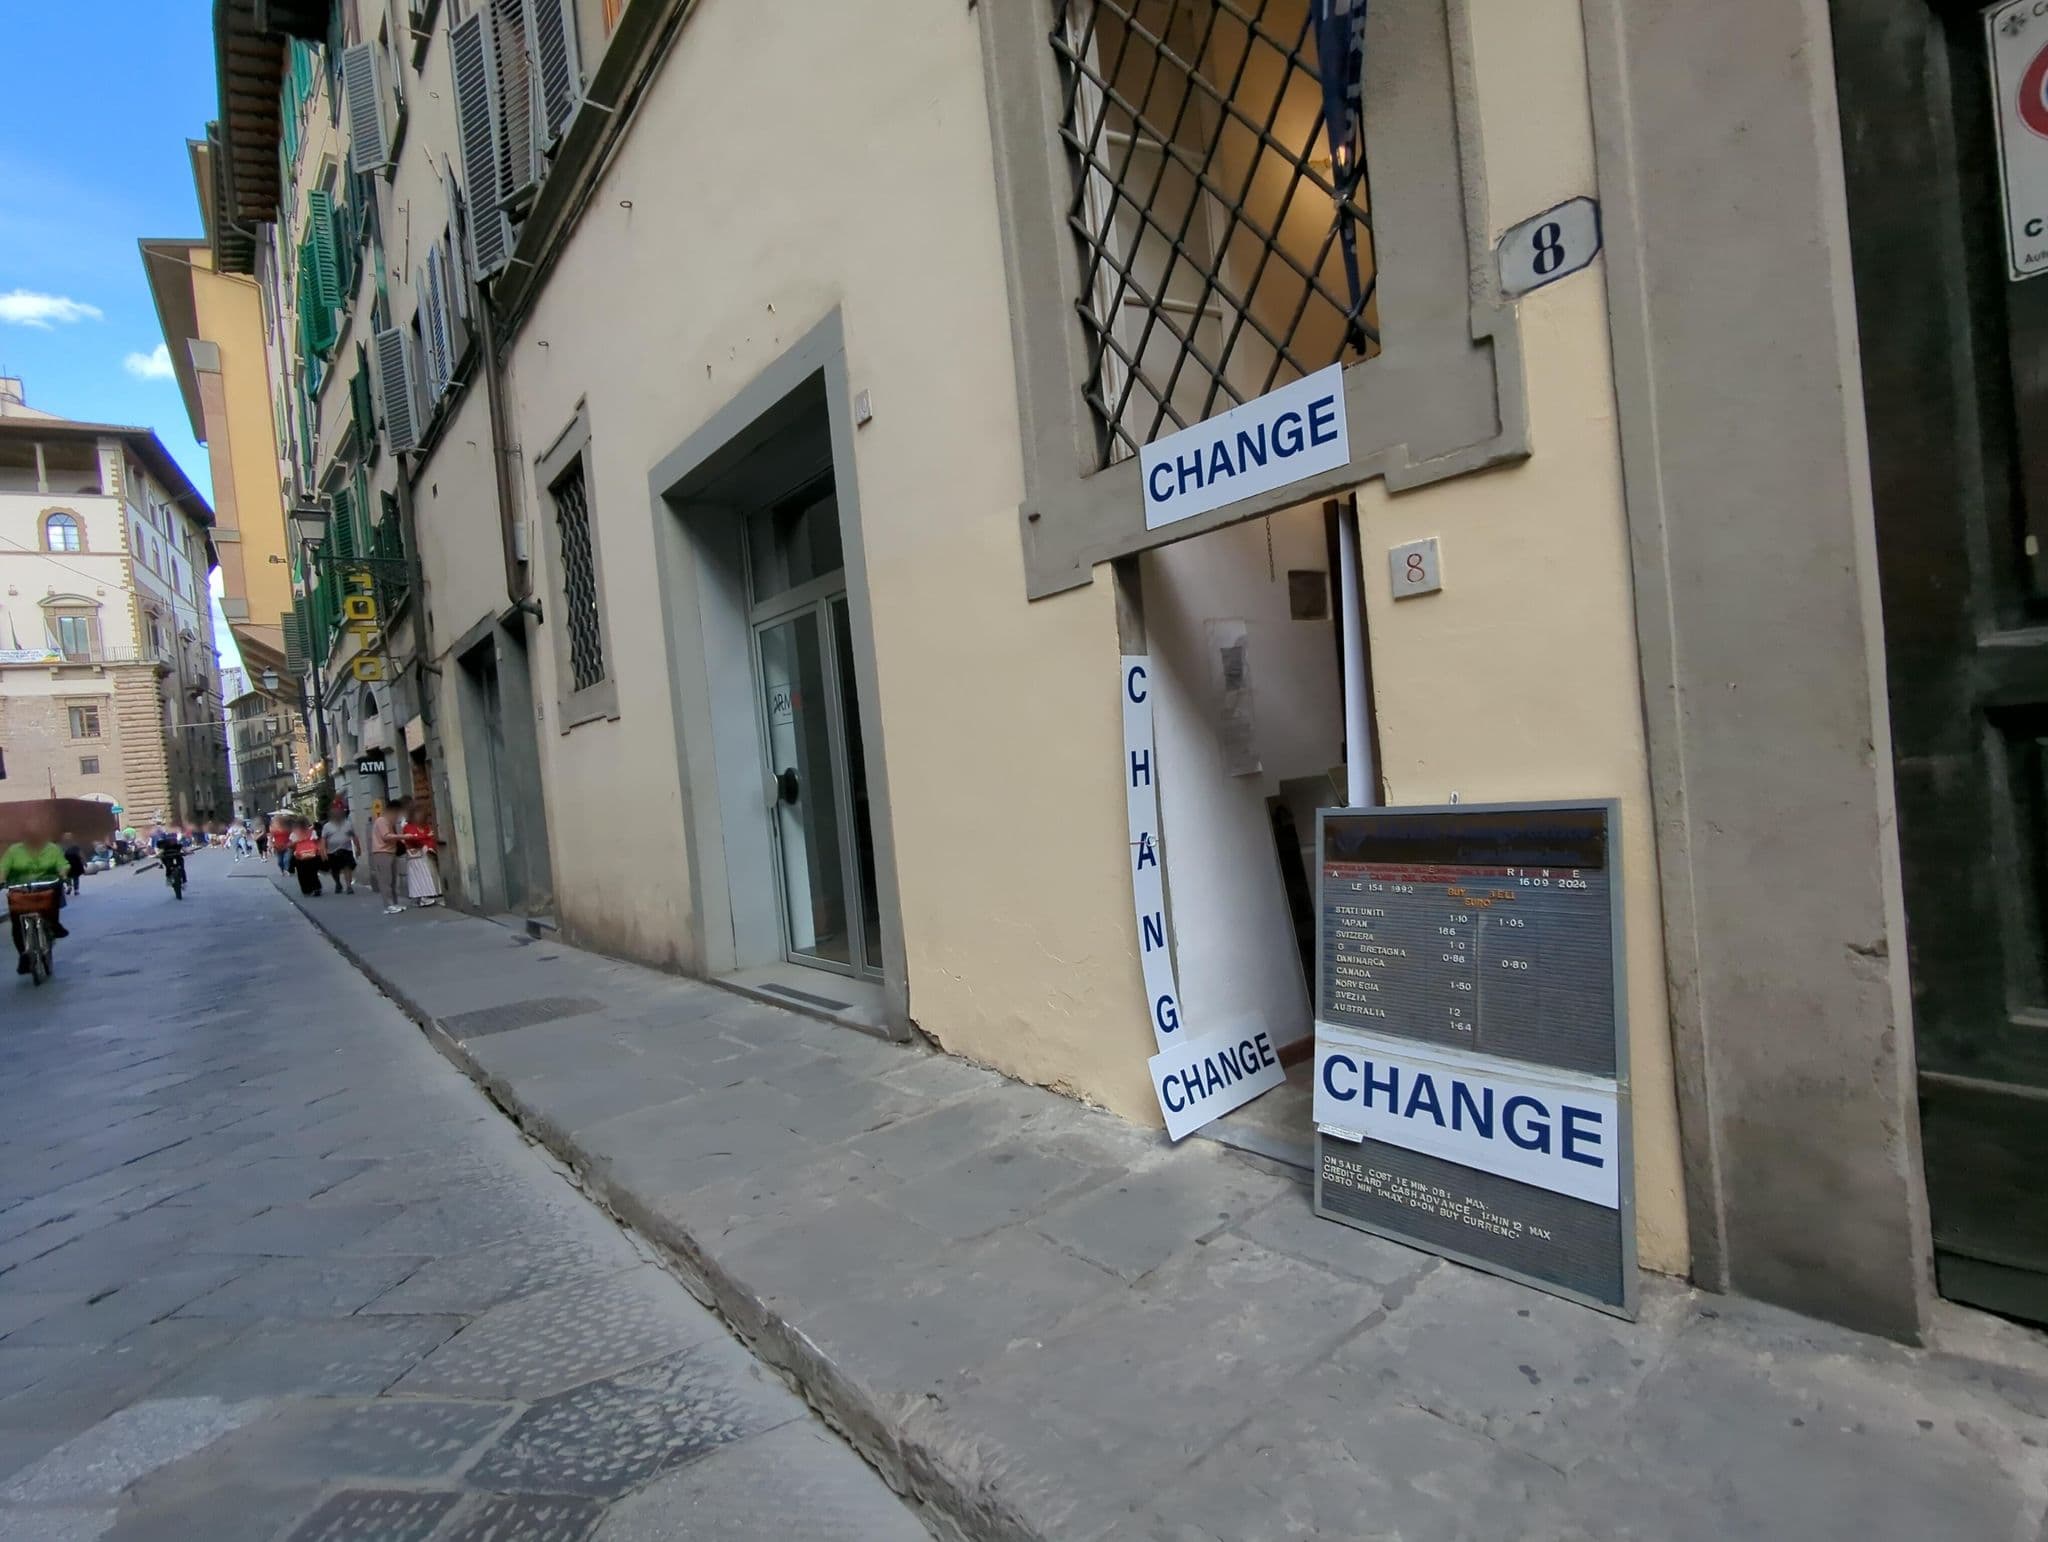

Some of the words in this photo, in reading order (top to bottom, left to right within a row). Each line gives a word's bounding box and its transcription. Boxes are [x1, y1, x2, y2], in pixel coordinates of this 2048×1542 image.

[1532, 222, 1565, 274] 8
[1149, 395, 1338, 503] CHANGE
[1406, 553, 1425, 583] 8
[360, 761, 385, 773] ATM
[1351, 883, 1363, 891] LE
[1558, 879, 1588, 889] 2024
[1447, 887, 1467, 897] BUY
[1335, 906, 1358, 915] STATI
[1360, 908, 1384, 917] UNITI
[1335, 930, 1375, 941] SVIZZERA
[1336, 967, 1371, 979] CANADA
[1335, 991, 1367, 1003] SVEZIA
[1332, 1003, 1386, 1018] AUSTRALIA
[1162, 1031, 1276, 1113] CHANGE
[1322, 1054, 1604, 1169] CHANGE
[1369, 1169, 1393, 1182] COST
[1322, 1172, 1353, 1187] COSTO
[1440, 1207, 1460, 1220] BUY
[1391, 1184, 1418, 1199] CASH
[1420, 1193, 1471, 1215] ADVANCE
[1529, 1226, 1551, 1241] MAX
